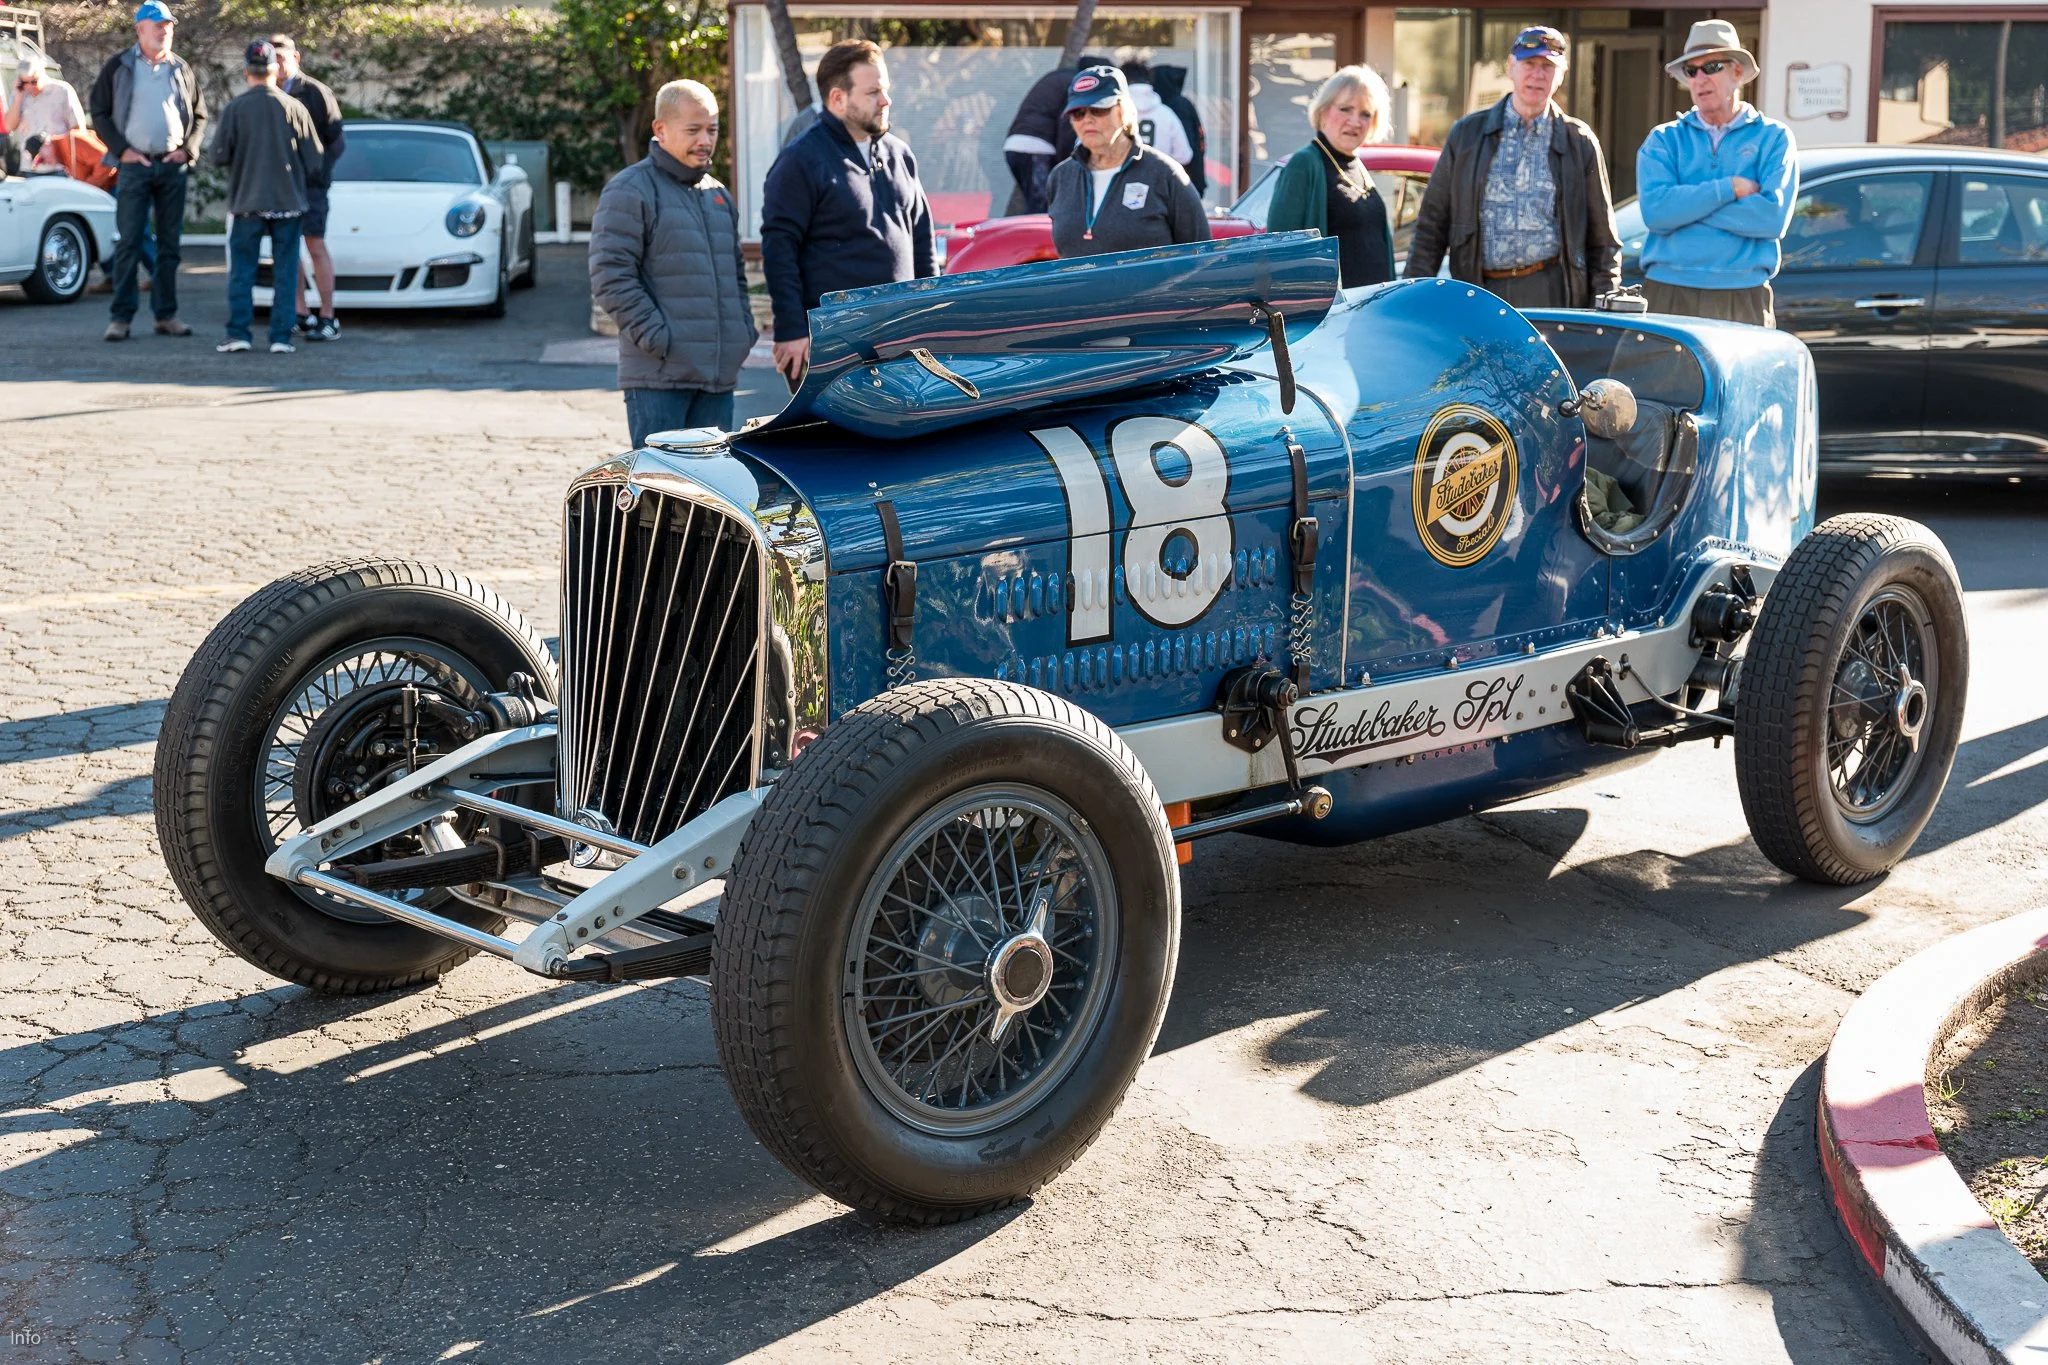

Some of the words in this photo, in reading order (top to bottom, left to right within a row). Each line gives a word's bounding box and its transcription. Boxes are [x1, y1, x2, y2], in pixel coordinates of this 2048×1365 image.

[1435, 460, 1498, 510] Studebaker
[1022, 413, 1236, 648] 18
[1456, 513, 1494, 552] Special
[1289, 700, 1446, 762] Studebaker
[1453, 673, 1525, 734] Spl
